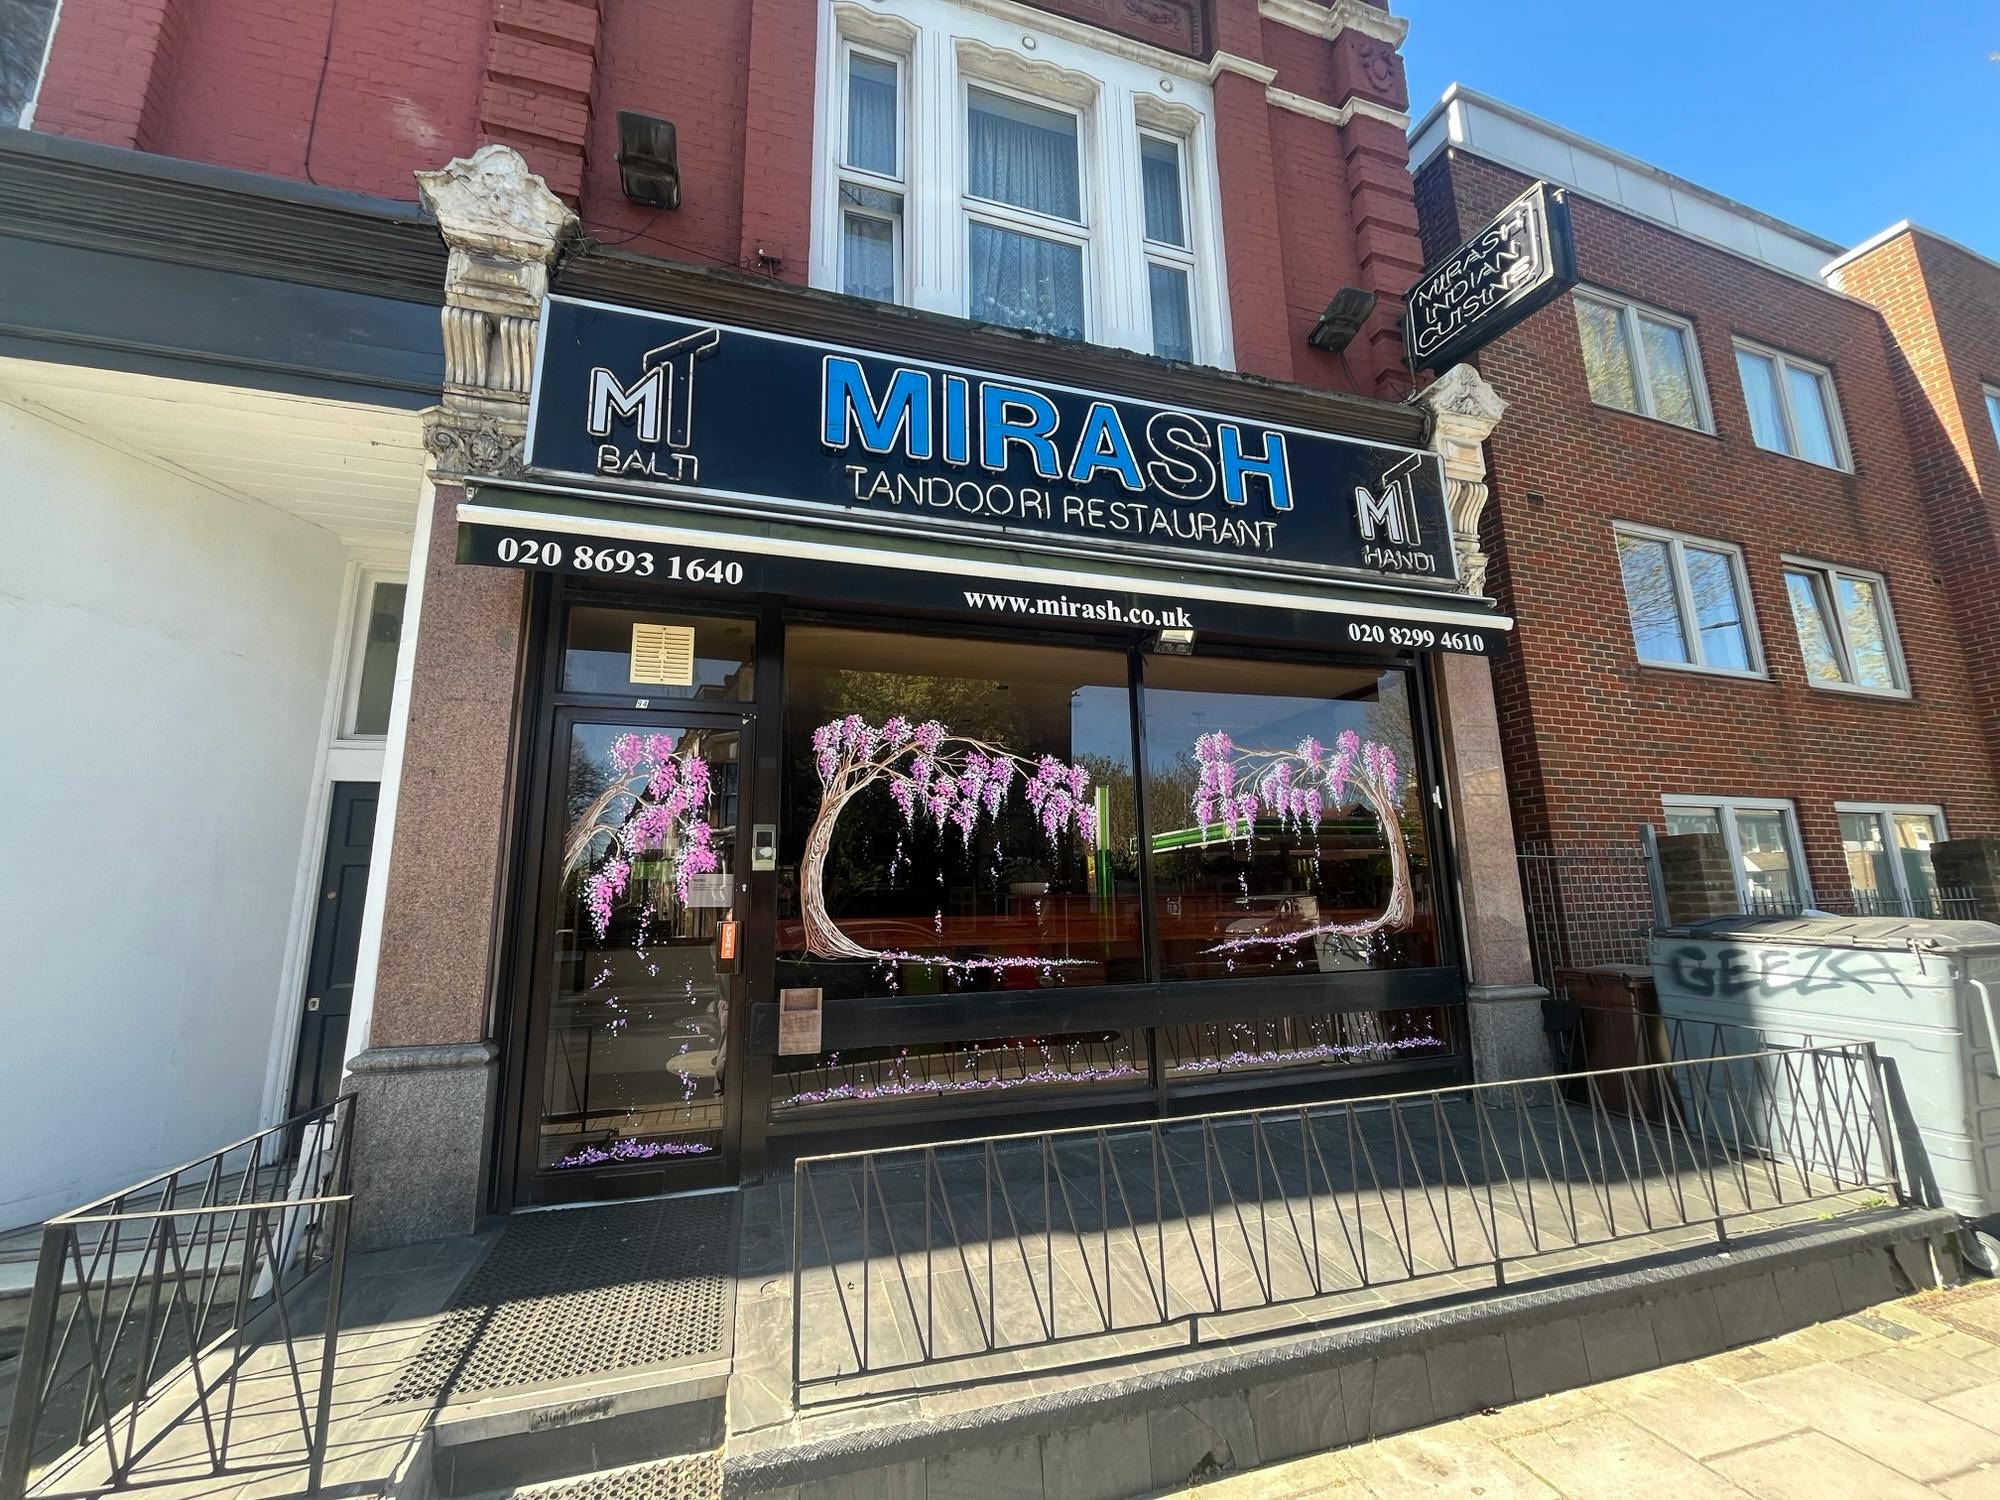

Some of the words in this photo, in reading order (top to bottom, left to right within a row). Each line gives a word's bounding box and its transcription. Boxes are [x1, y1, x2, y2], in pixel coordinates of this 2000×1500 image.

[1419, 210, 1525, 306] MIRASH
[1426, 239, 1519, 324] INDIAN
[1419, 256, 1530, 348] CUISINE
[597, 444, 699, 481] BALTI
[820, 354, 1294, 512] MIRASH
[845, 465, 1051, 520] TANDOORI
[1063, 496, 1279, 552] RESTAURANT
[497, 537, 562, 567] 020
[573, 545, 654, 577] 8693
[667, 554, 744, 586] 1640
[1361, 543, 1436, 573] HANDI
[963, 591, 1193, 629] www.mirash.co.uk
[1347, 622, 1385, 645] 020
[1390, 626, 1435, 649] 8299
[1440, 631, 1485, 653] 4610
